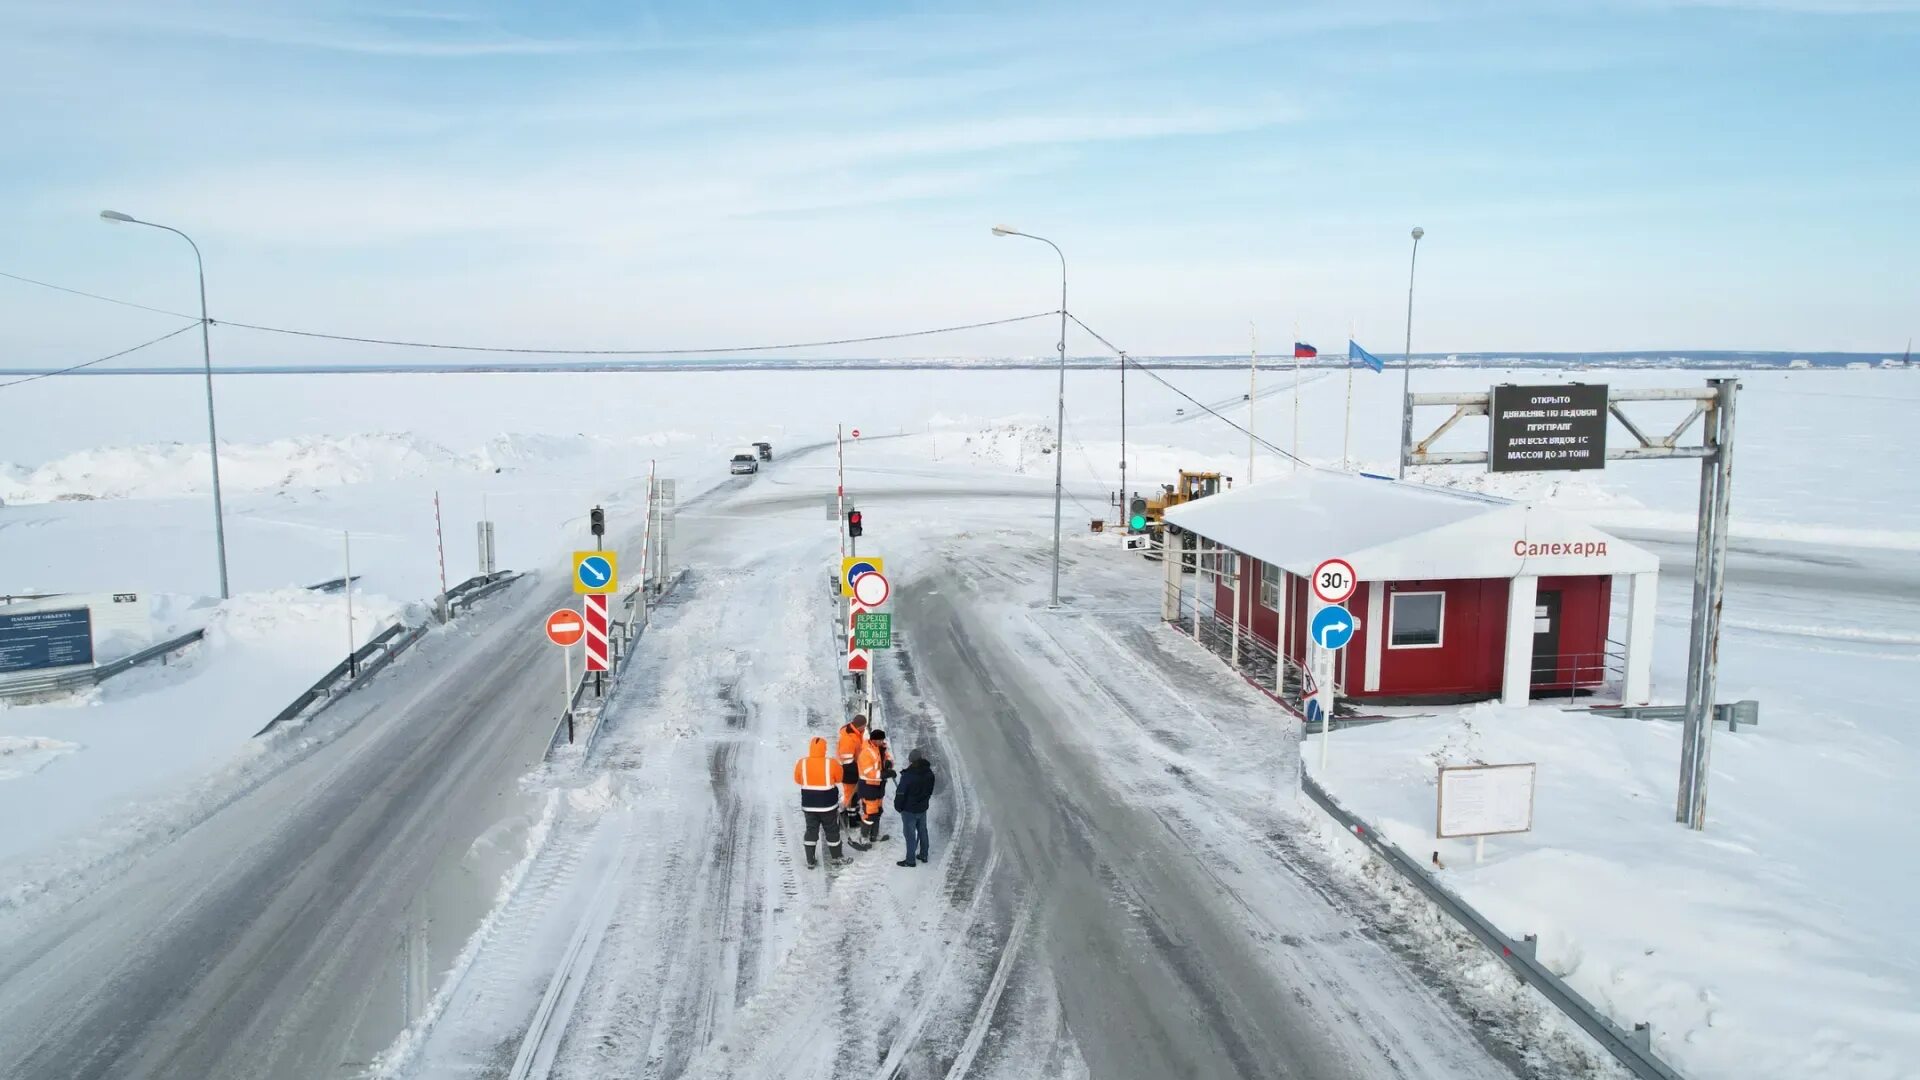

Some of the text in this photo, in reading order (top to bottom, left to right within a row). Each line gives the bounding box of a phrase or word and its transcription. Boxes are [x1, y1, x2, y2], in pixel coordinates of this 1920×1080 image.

[1531, 396, 1571, 404] ОТКРЫТО
[1544, 450, 1556, 459] ДО
[1514, 540, 1607, 557] Салехард
[860, 630, 869, 638] ПО
